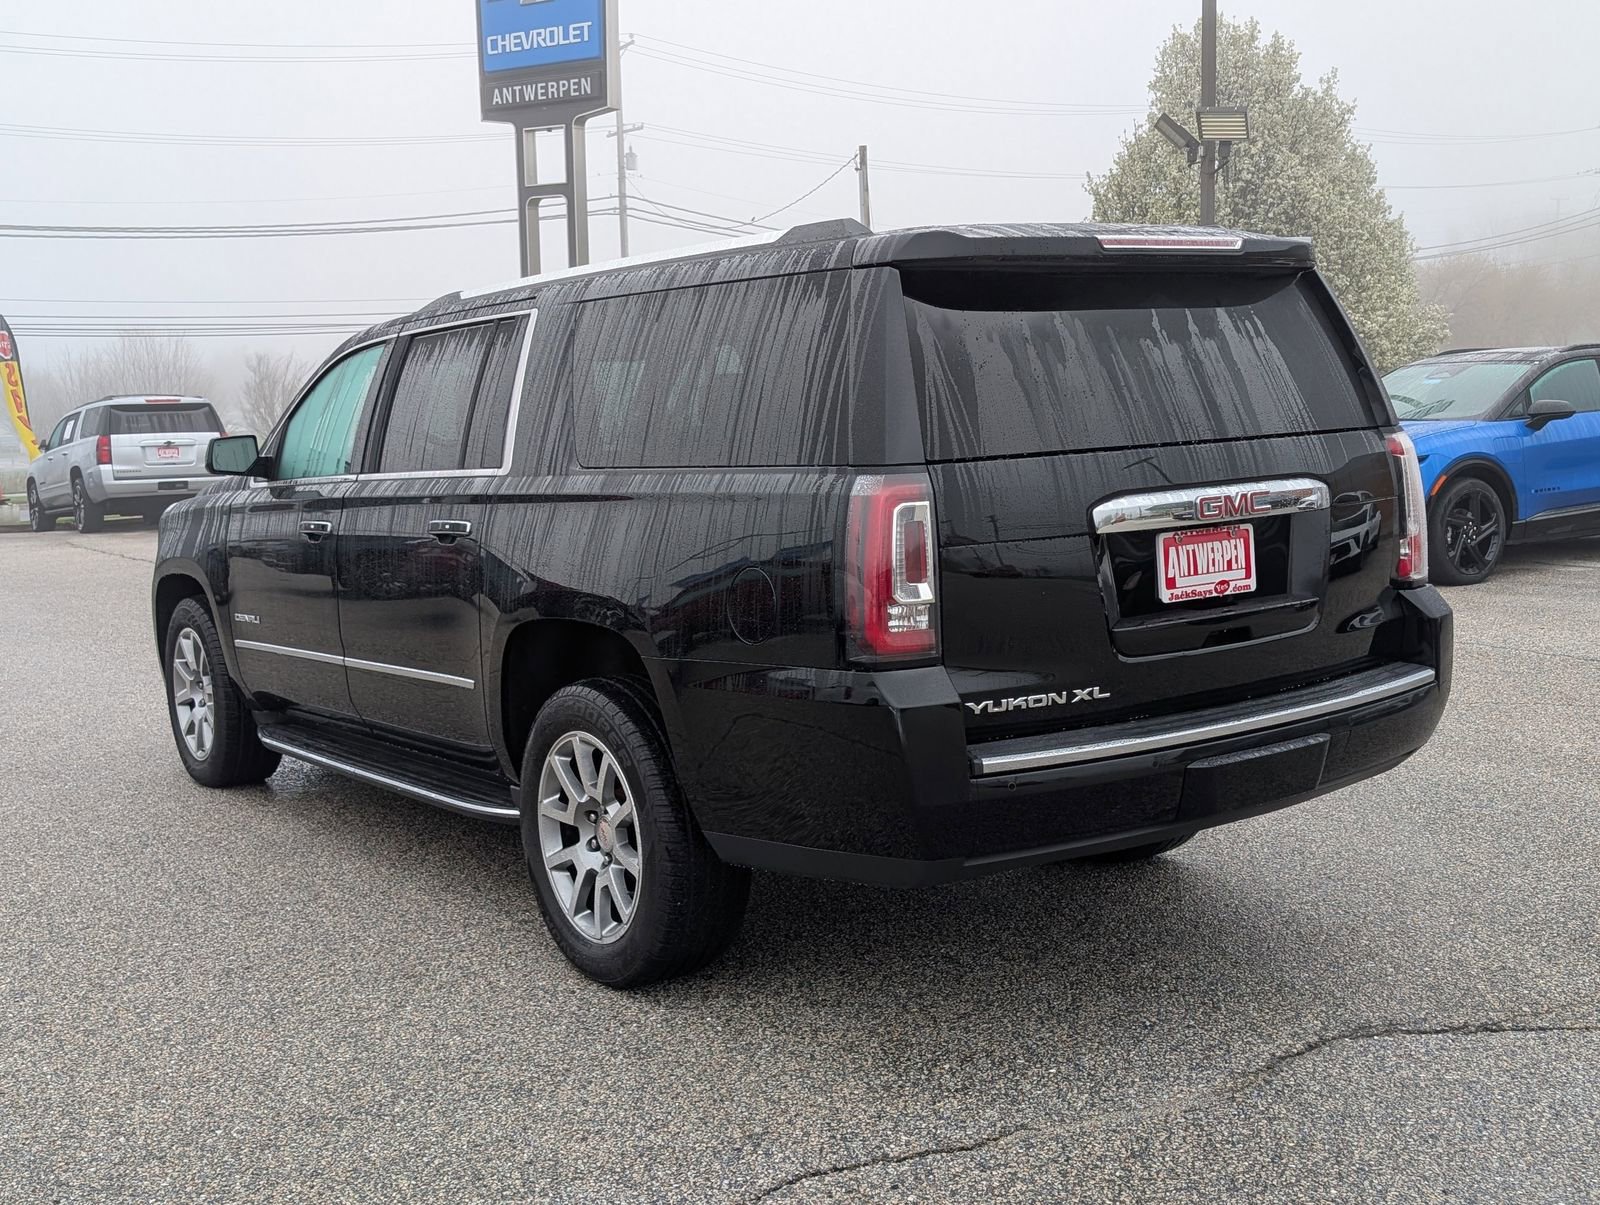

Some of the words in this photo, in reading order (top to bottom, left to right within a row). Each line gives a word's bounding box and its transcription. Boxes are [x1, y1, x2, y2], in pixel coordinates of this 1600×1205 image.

[487, 21, 592, 55] CHEVROLET
[492, 77, 592, 105] ANTWERPEN
[1196, 489, 1272, 520] GMC
[1167, 538, 1246, 582] ANTWERPEN
[964, 691, 1067, 715] YUKON
[1071, 686, 1111, 703] XL
